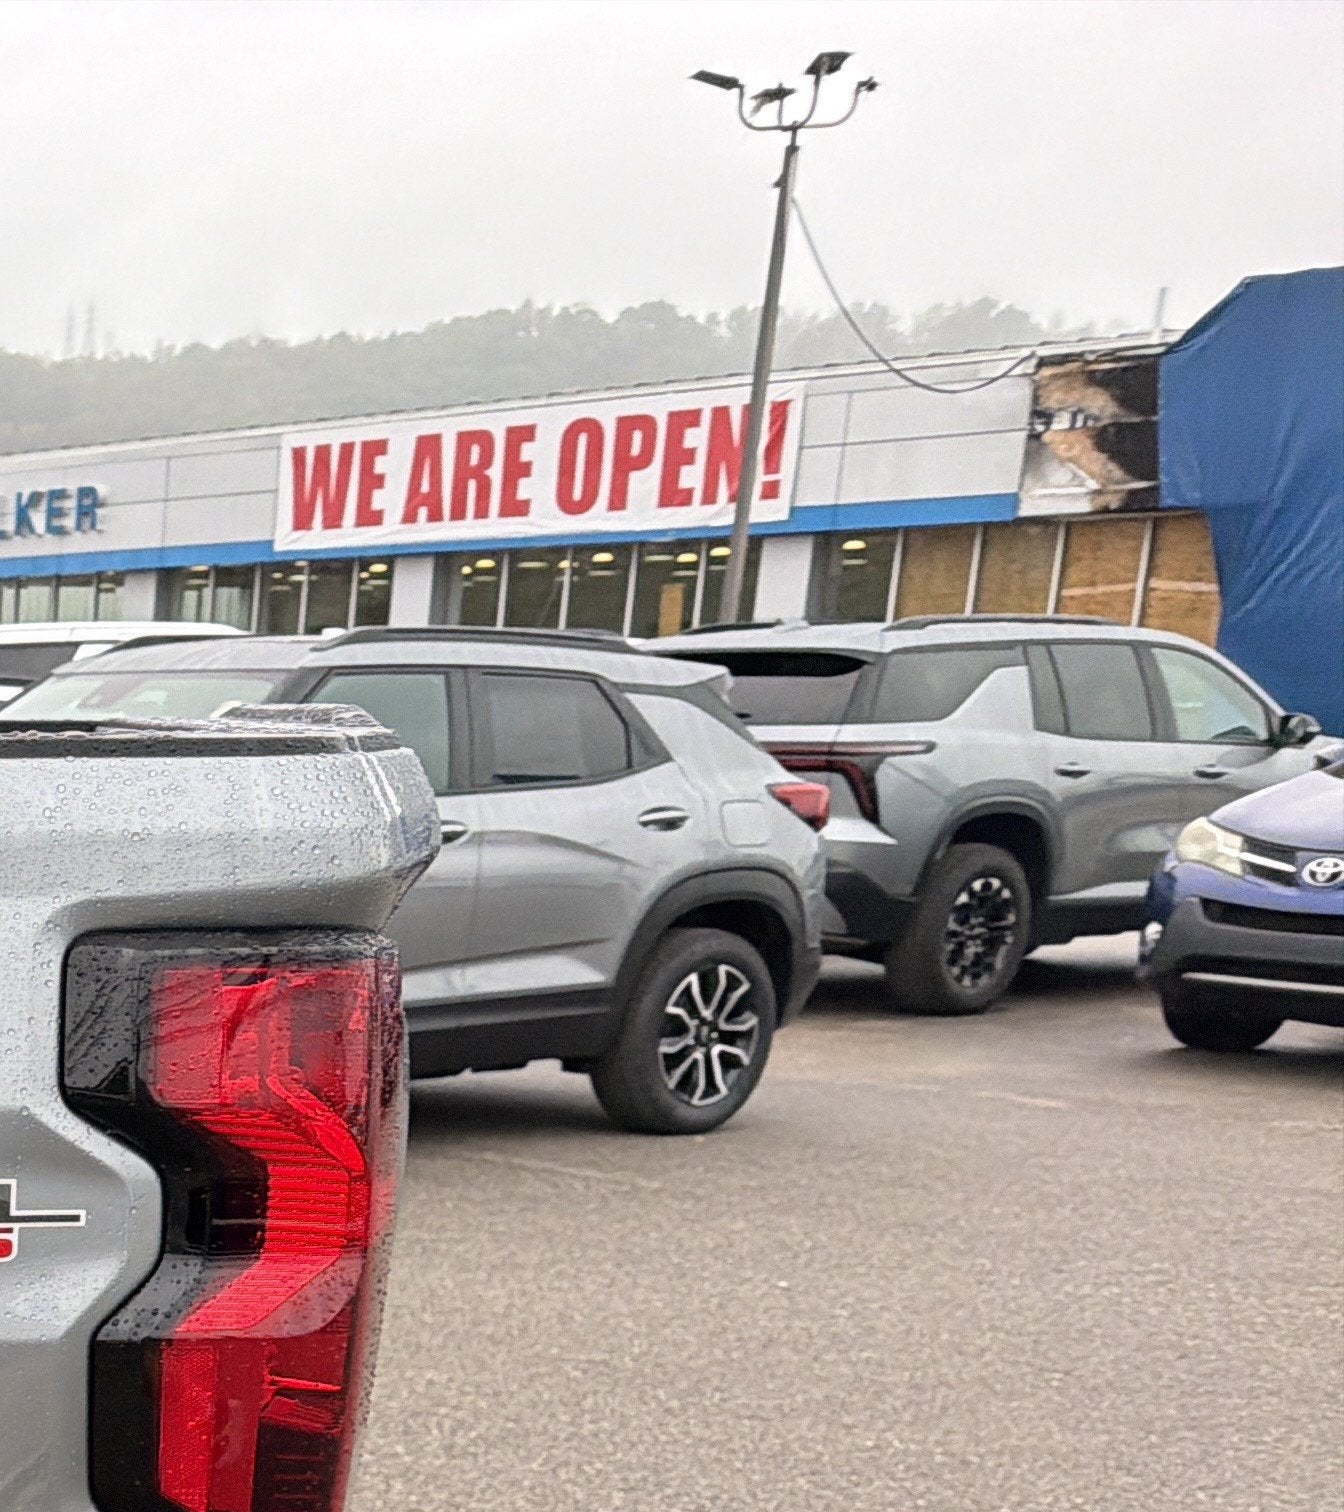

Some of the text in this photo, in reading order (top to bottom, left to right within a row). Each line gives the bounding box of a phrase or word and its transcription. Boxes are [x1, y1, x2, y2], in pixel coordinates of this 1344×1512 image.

[291, 399, 794, 532] WE ARE OPEN!
